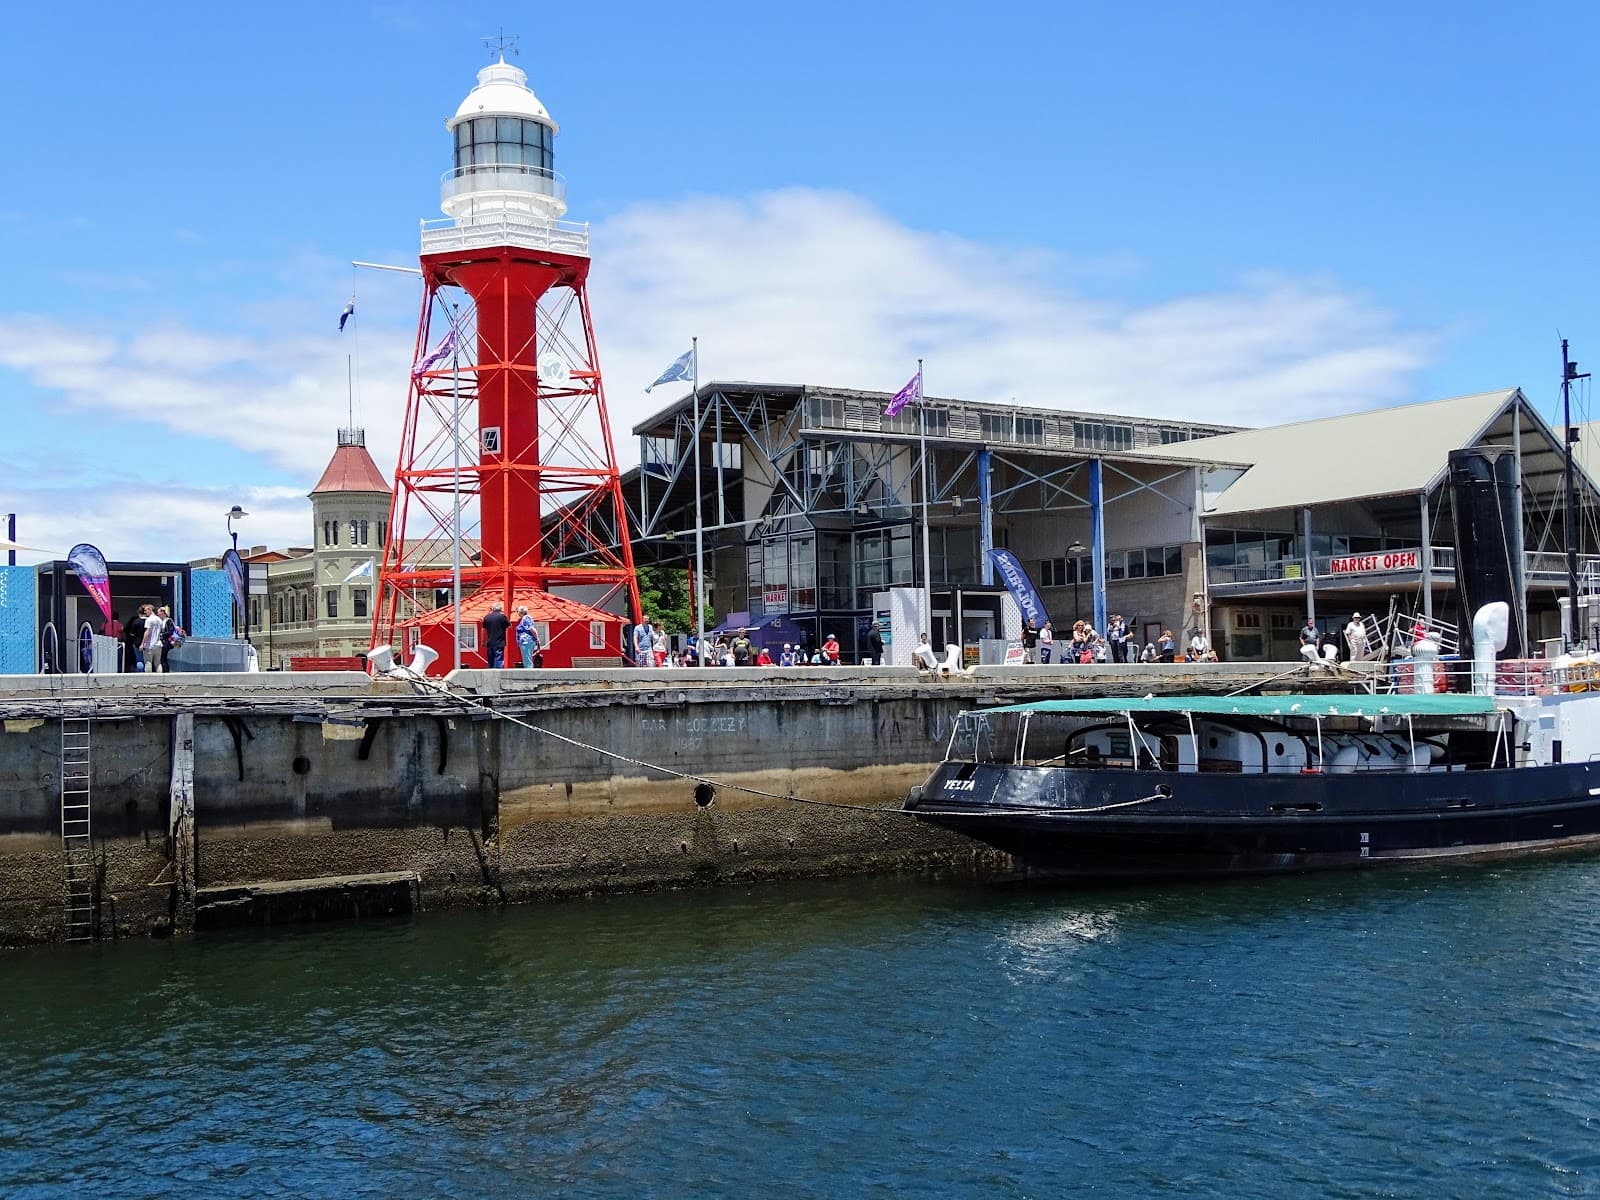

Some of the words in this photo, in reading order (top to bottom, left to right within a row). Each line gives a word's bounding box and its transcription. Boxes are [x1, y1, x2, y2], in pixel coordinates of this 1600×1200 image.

[1331, 556, 1378, 573] MARKET
[1383, 552, 1416, 569] OPEN
[765, 592, 787, 603] MARKET
[943, 780, 975, 791] YELTA
